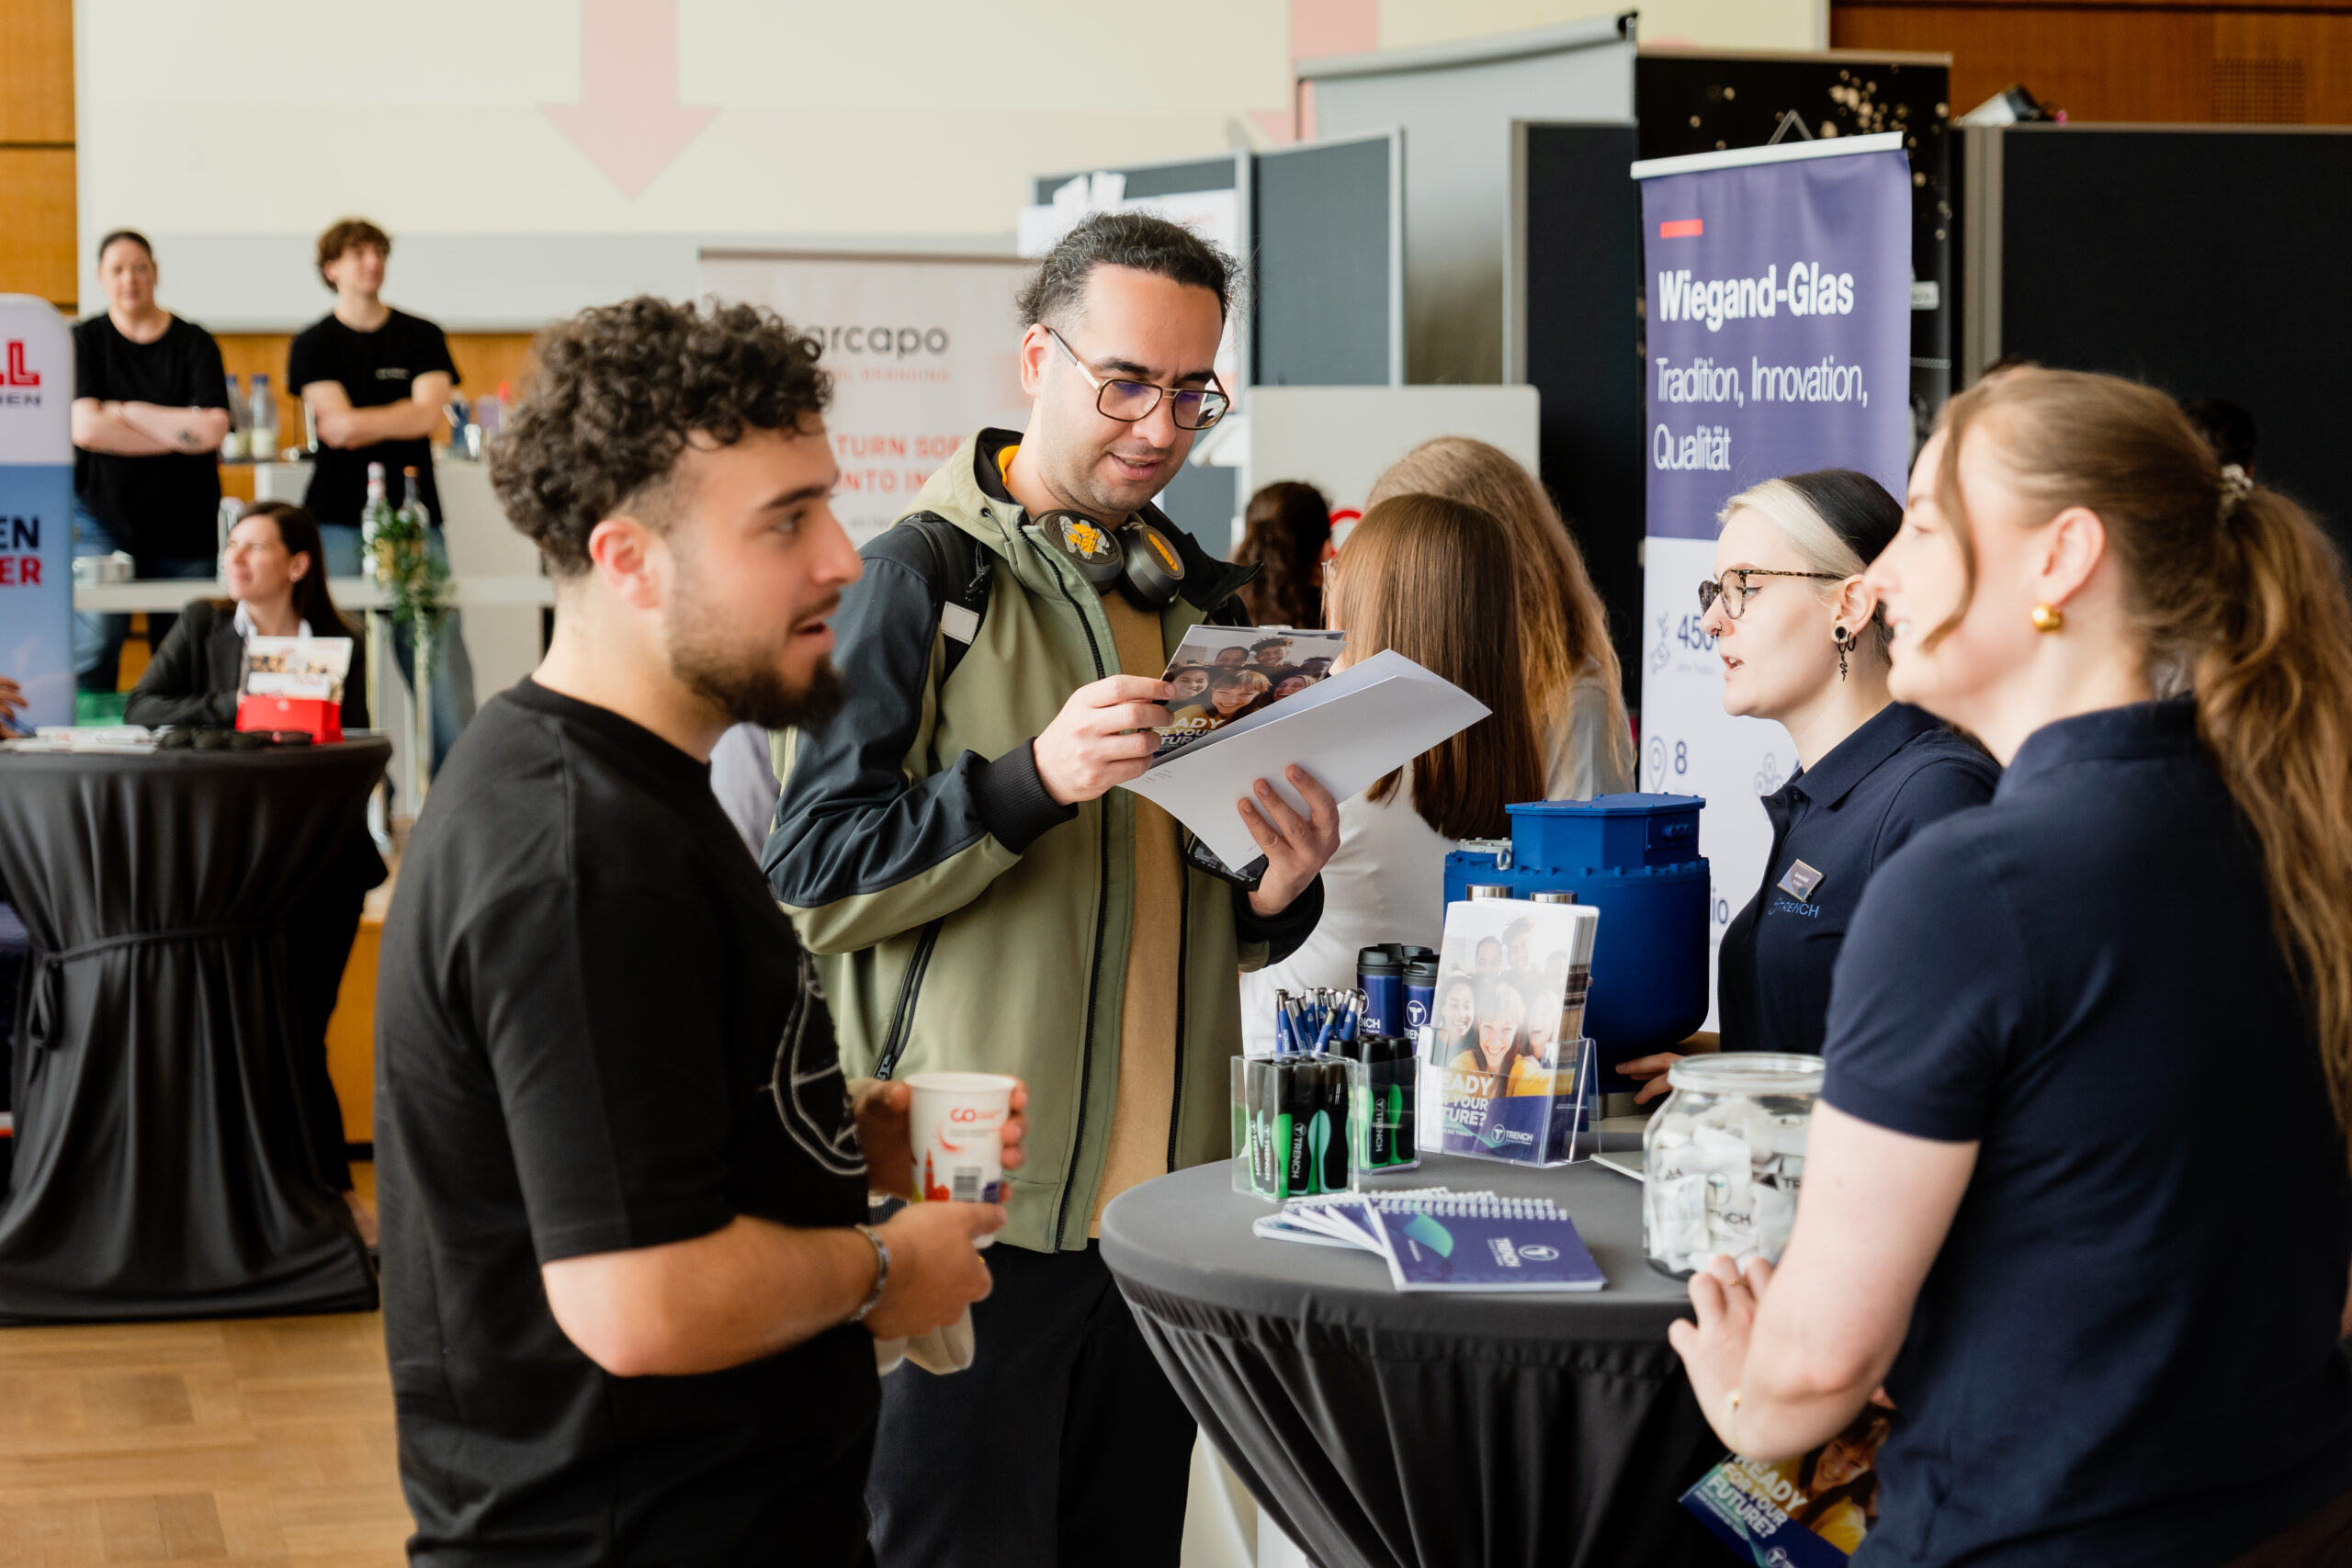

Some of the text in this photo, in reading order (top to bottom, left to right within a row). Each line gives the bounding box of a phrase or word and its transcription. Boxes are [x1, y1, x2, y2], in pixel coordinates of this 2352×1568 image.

[1658, 261, 1855, 333] Wiegand-Glas
[804, 325, 949, 358] arcapo
[0, 339, 41, 387] L
[1656, 354, 1868, 409] Tradition, Innovation,
[0, 392, 41, 406] EN
[835, 434, 906, 459] TURN
[1654, 423, 1731, 471] Qualität
[1678, 614, 1718, 651] 450
[1154, 716, 1226, 730] ADY
[1674, 740, 1688, 775] 8
[1711, 886, 1729, 925] io
[1359, 1016, 1381, 1029] ENCH
[1441, 1072, 1495, 1096] EADY
[1441, 1106, 1487, 1127] TURE?
[1453, 1095, 1489, 1111] YOUR
[1375, 1111, 1384, 1152] TRENCH
[1505, 1130, 1533, 1142] TRENCH
[1252, 1134, 1261, 1176] TRENCH
[1291, 1136, 1303, 1179] TRENCH
[1706, 1473, 1778, 1539] FUTURE?
[1749, 1487, 1790, 1528] YOUR
